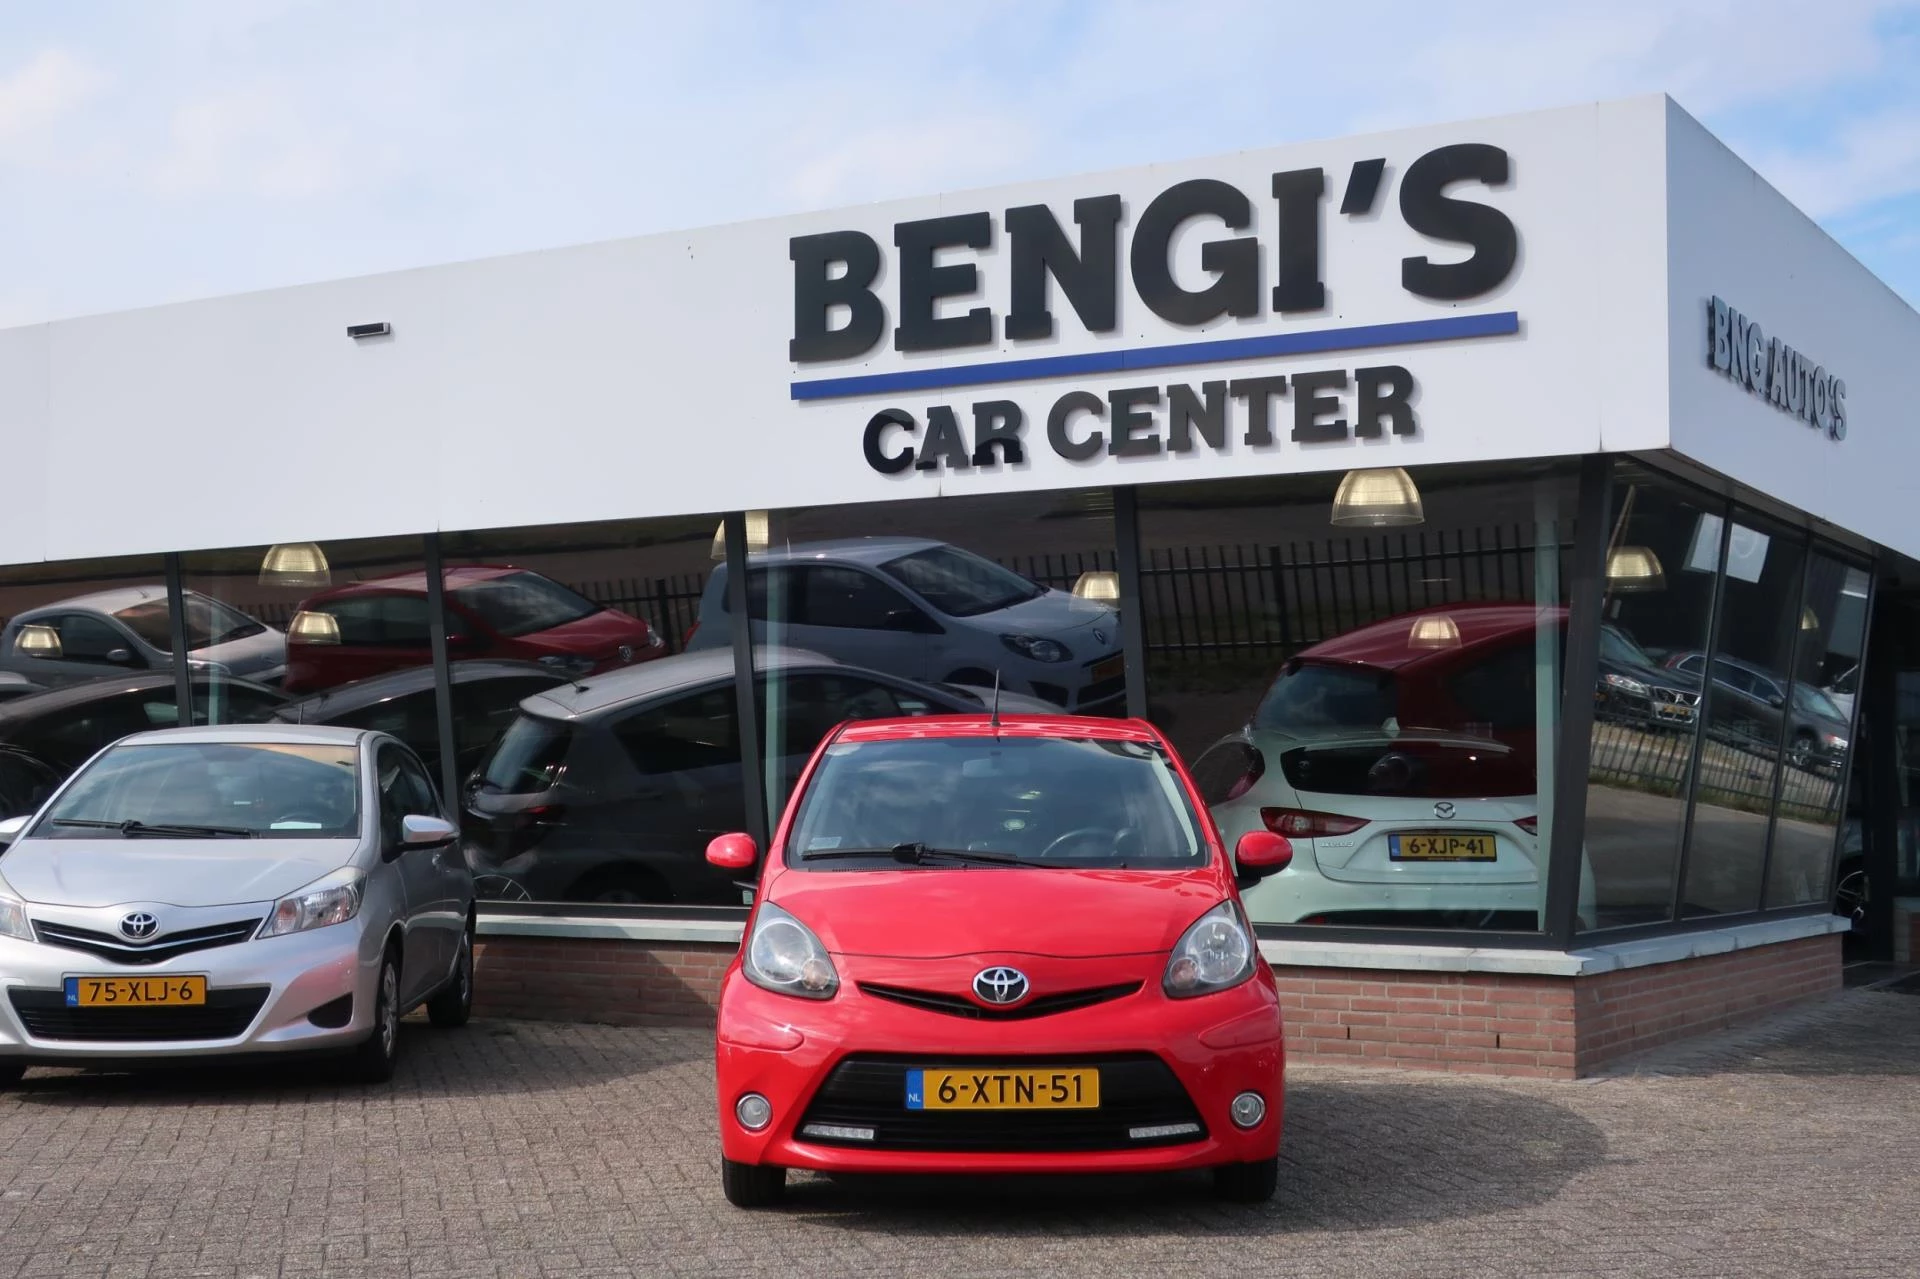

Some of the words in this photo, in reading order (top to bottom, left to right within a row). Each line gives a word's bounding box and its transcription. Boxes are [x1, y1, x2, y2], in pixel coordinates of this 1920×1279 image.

[790, 143, 1517, 362] BENGI'S
[1711, 295, 1768, 394] BNG
[1770, 336, 1848, 441] AUTO'S
[863, 399, 1023, 474] CAR
[1046, 364, 1416, 461] CENTER
[1409, 838, 1485, 855] 6-XJP-41
[88, 981, 193, 1002] 75-XLJ-6
[908, 1093, 921, 1103] NL
[938, 1074, 1082, 1104] 6-XTN-51
